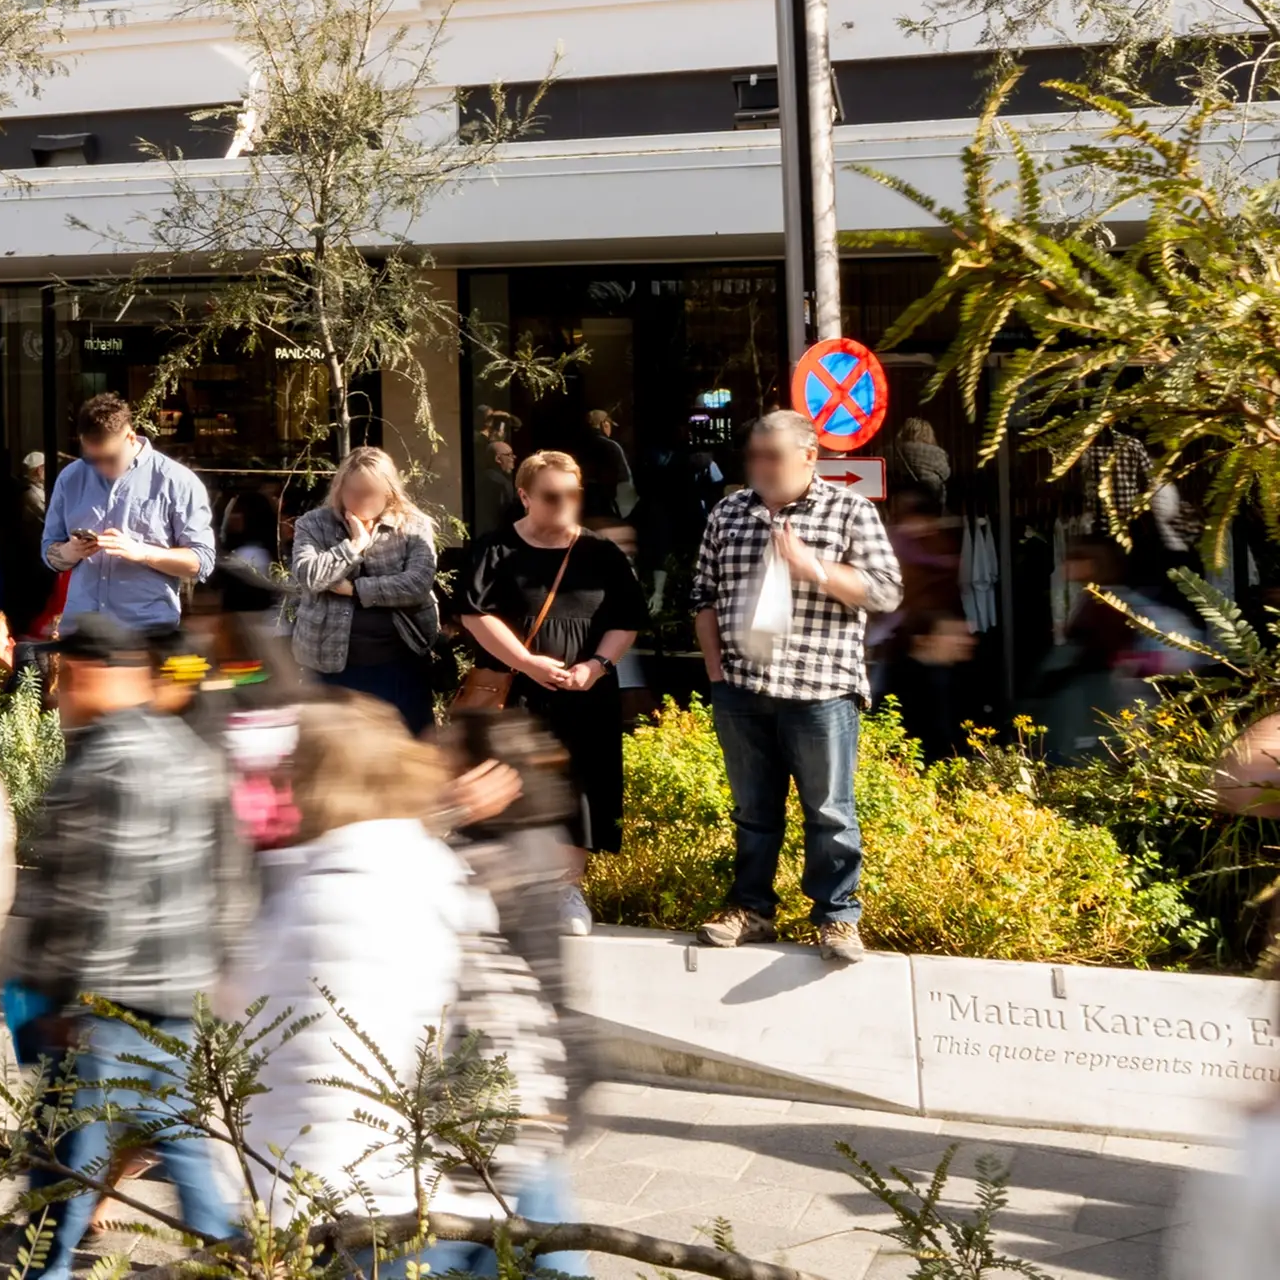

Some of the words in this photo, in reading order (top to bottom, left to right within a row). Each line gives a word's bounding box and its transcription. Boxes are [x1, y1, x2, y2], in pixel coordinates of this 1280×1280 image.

[932, 1034, 981, 1057] This
[988, 1041, 1057, 1066] quote
[1064, 1048, 1192, 1075] represents
